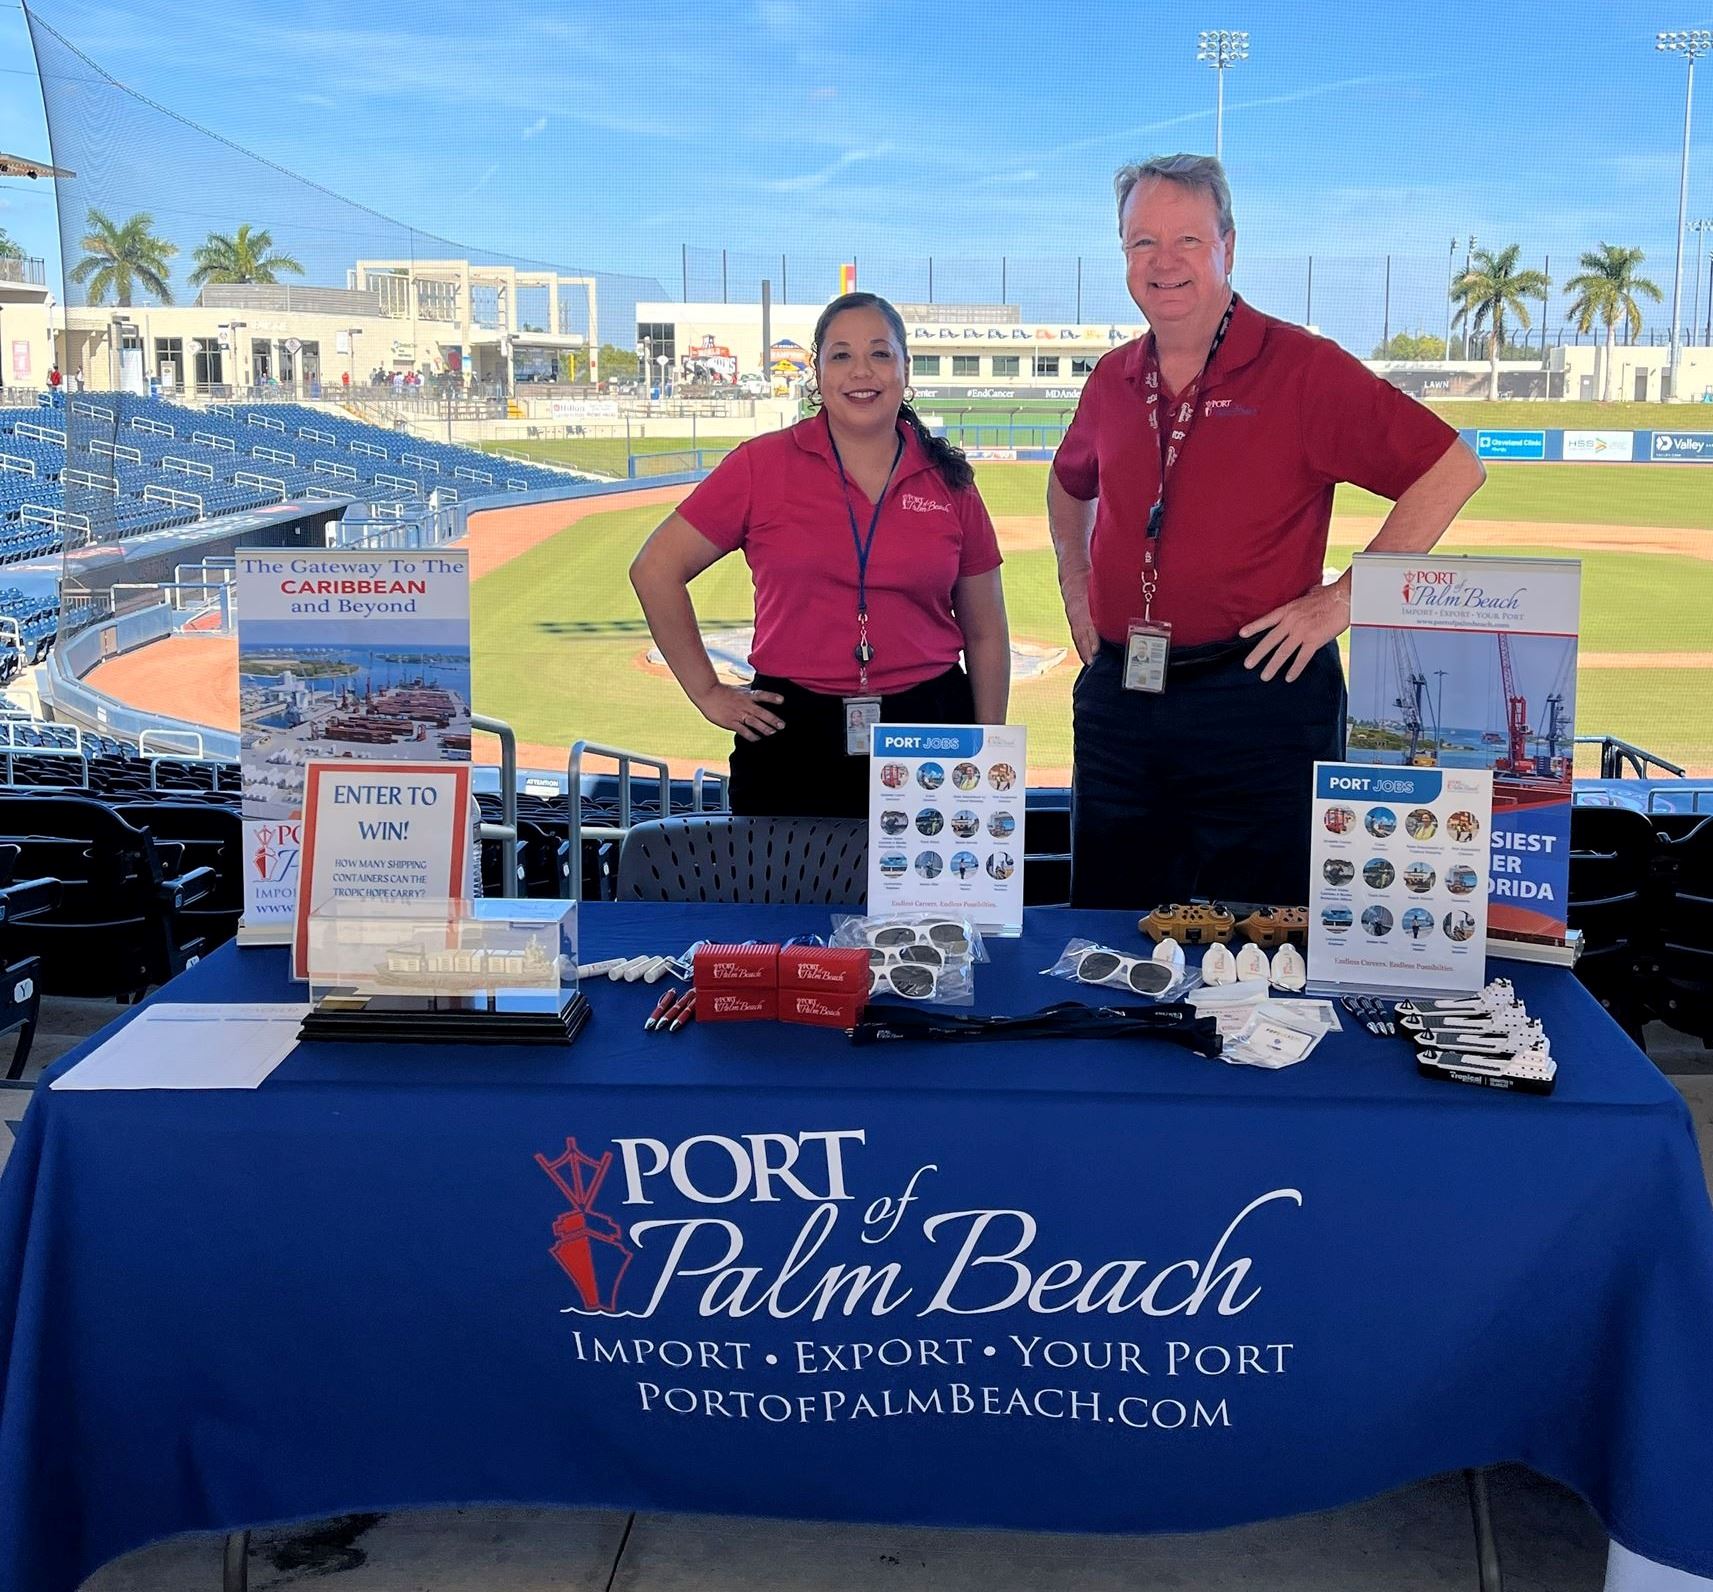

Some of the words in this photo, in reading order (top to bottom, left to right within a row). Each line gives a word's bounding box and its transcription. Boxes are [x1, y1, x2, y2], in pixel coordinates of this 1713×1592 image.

[1424, 380, 1449, 389] LAWN
[967, 389, 1015, 398] #EndCancer
[1491, 439, 1523, 447] Cleveland
[1523, 439, 1542, 447] Clinic
[1568, 439, 1594, 448] HSS
[1673, 438, 1704, 453] Valley
[241, 559, 283, 574] The
[290, 559, 382, 578] Gateway
[389, 559, 416, 573] To
[422, 559, 464, 574] The
[1417, 571, 1456, 585] PORT
[281, 580, 426, 594] CARIBBEAN
[1416, 584, 1461, 606] Palm
[1464, 588, 1527, 609] Beach
[291, 599, 330, 613] and
[338, 599, 416, 618] Beyond
[1401, 608, 1433, 616] IMPORT
[1440, 609, 1470, 618] EXPORT
[1502, 612, 1525, 620] PORT
[885, 737, 921, 749] PORT
[923, 738, 960, 750] JOBS
[527, 778, 559, 787] ATTENTION
[1329, 777, 1371, 791] PORT
[1372, 780, 1415, 794] JOBS
[334, 785, 402, 805] ENTER
[408, 786, 438, 806] TO
[358, 820, 410, 841] WIN!
[1491, 831, 1557, 853] SIEST
[335, 859, 358, 868] HOW
[359, 860, 386, 869] MANY
[387, 860, 428, 869] SHIPPING
[1492, 854, 1522, 874] ER
[332, 873, 389, 883] CONTAINERS
[390, 875, 410, 884] CAN
[411, 875, 427, 884] THE
[333, 888, 366, 897] TROPIC
[367, 888, 391, 897] HOPE
[391, 889, 426, 898] CARRY?
[1334, 957, 1360, 966] Endless
[1389, 961, 1415, 970] Endless
[1449, 1071, 1482, 1085] Tropical
[611, 1129, 865, 1205] PORT
[861, 1164, 938, 1244] of
[629, 1202, 913, 1322] Palm
[917, 1188, 1302, 1318] Beach
[571, 1331, 751, 1370] IMPORT
[794, 1338, 973, 1374] EXPORT
[1009, 1335, 1148, 1376] YOUR
[1165, 1341, 1294, 1376] PORT
[637, 1381, 1233, 1429] PORTOFPALMBEACH.COM
